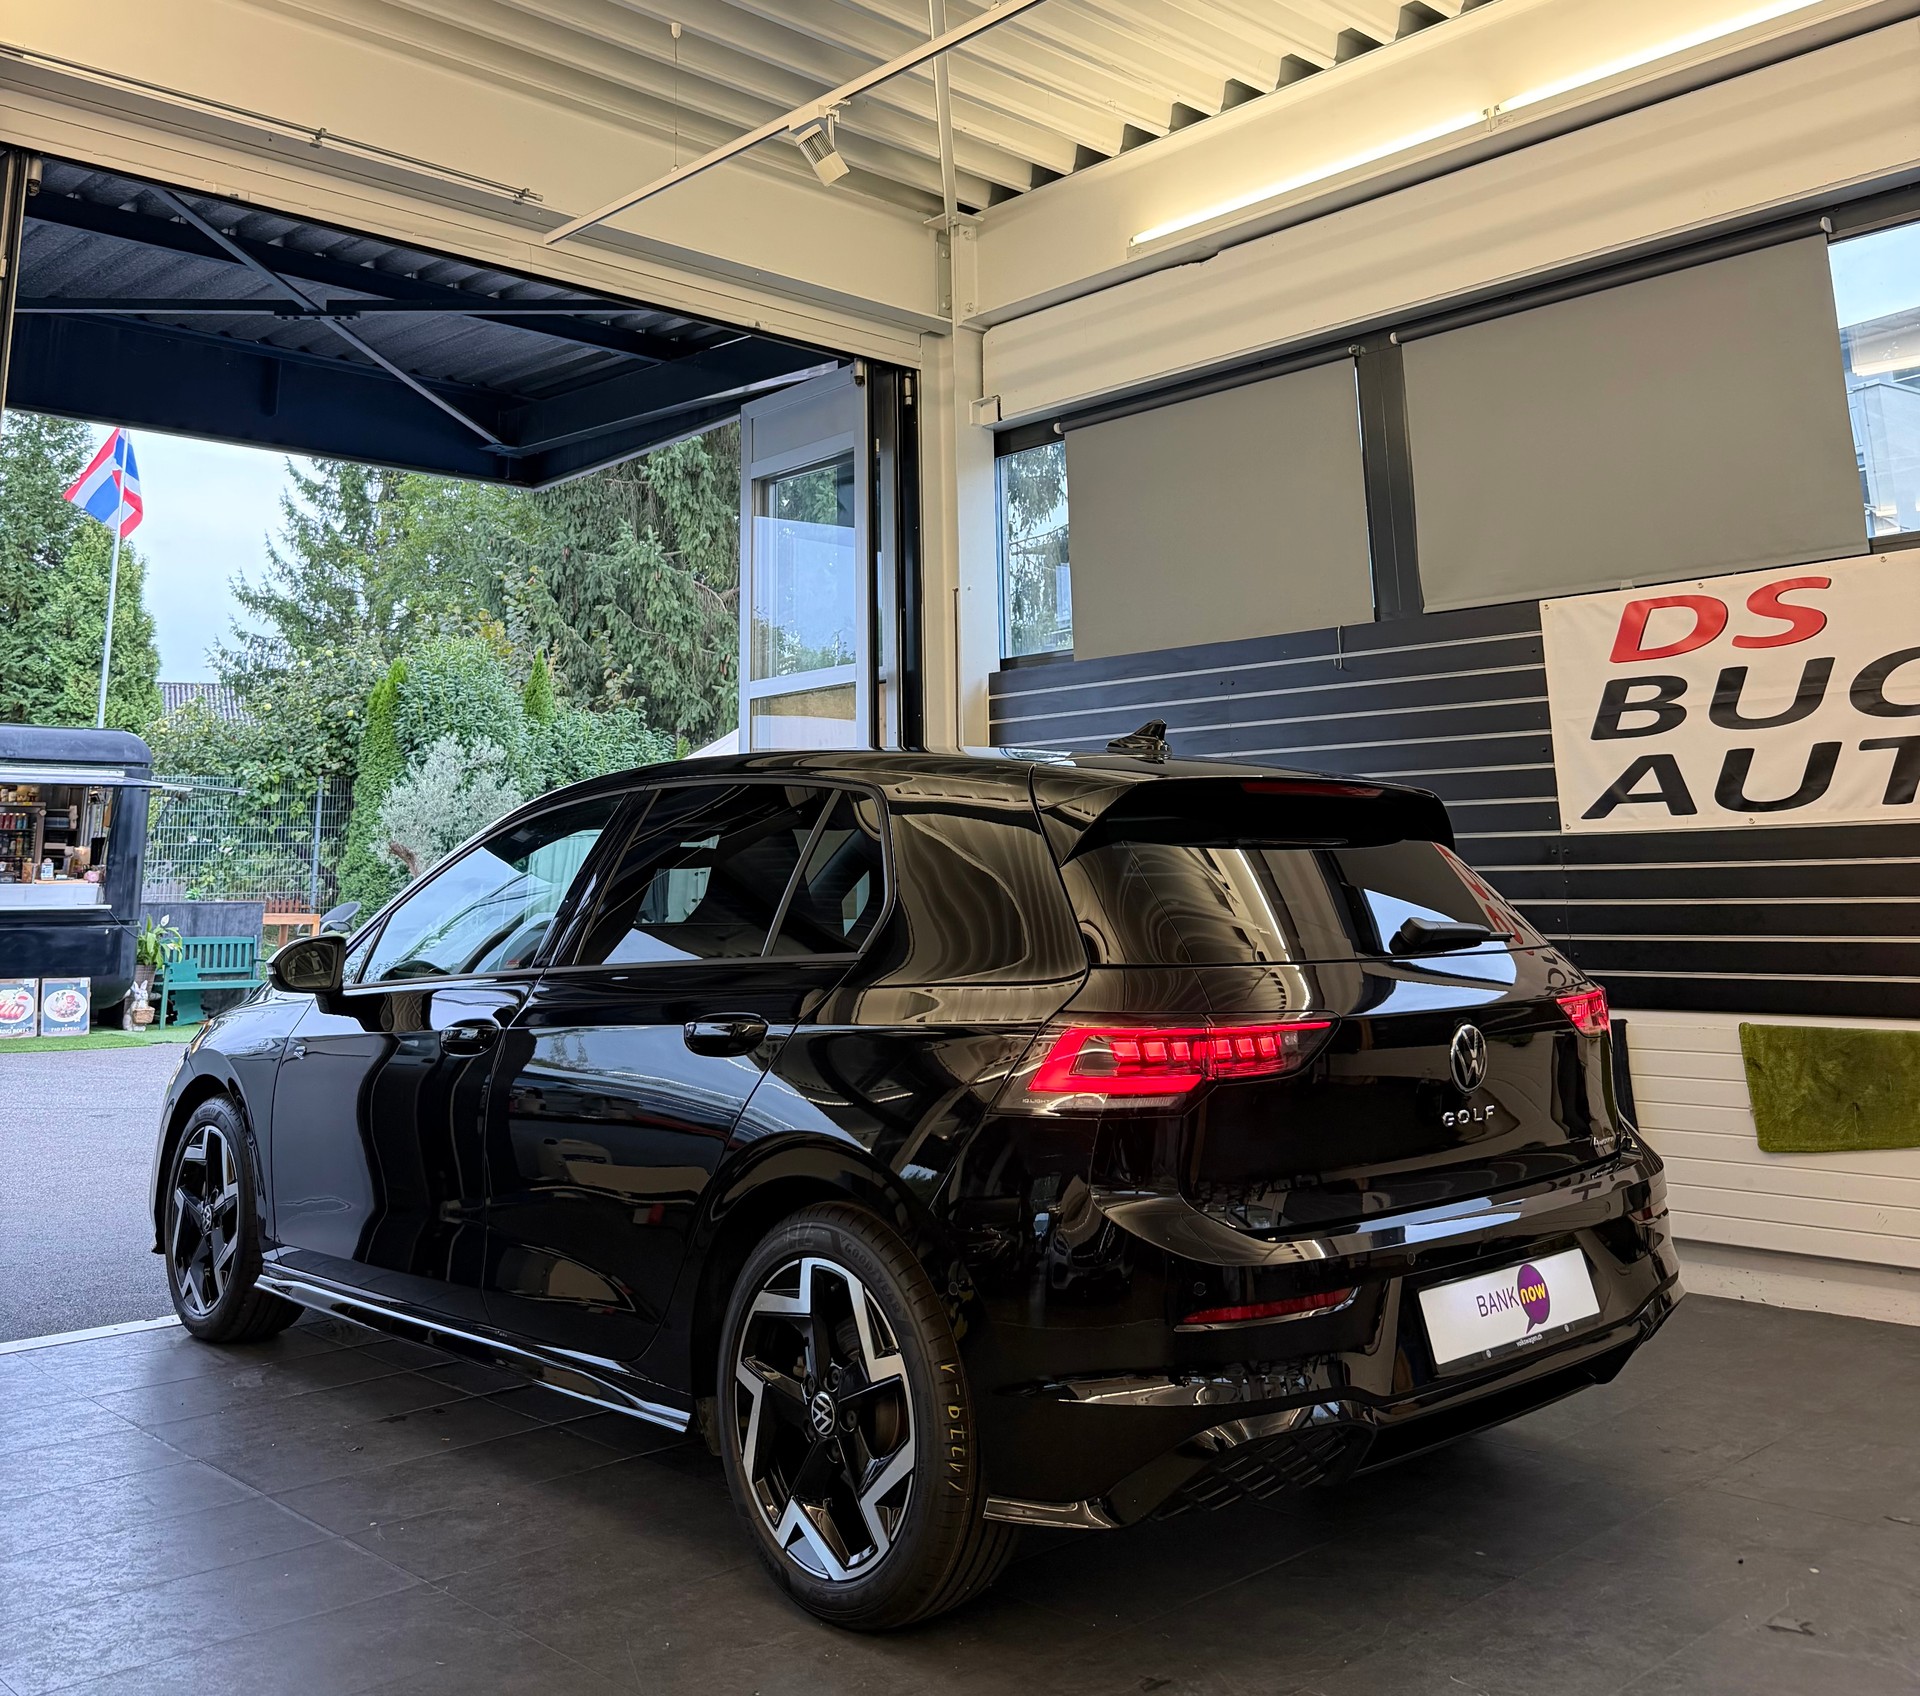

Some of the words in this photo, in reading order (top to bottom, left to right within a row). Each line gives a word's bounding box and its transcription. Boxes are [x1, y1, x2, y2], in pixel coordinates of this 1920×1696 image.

[1609, 577, 1832, 663] DS
[1581, 735, 1920, 819] AUT
[1443, 1105, 1496, 1127] GOLF
[1476, 1286, 1519, 1318] BANK
[1519, 1281, 1546, 1305] now
